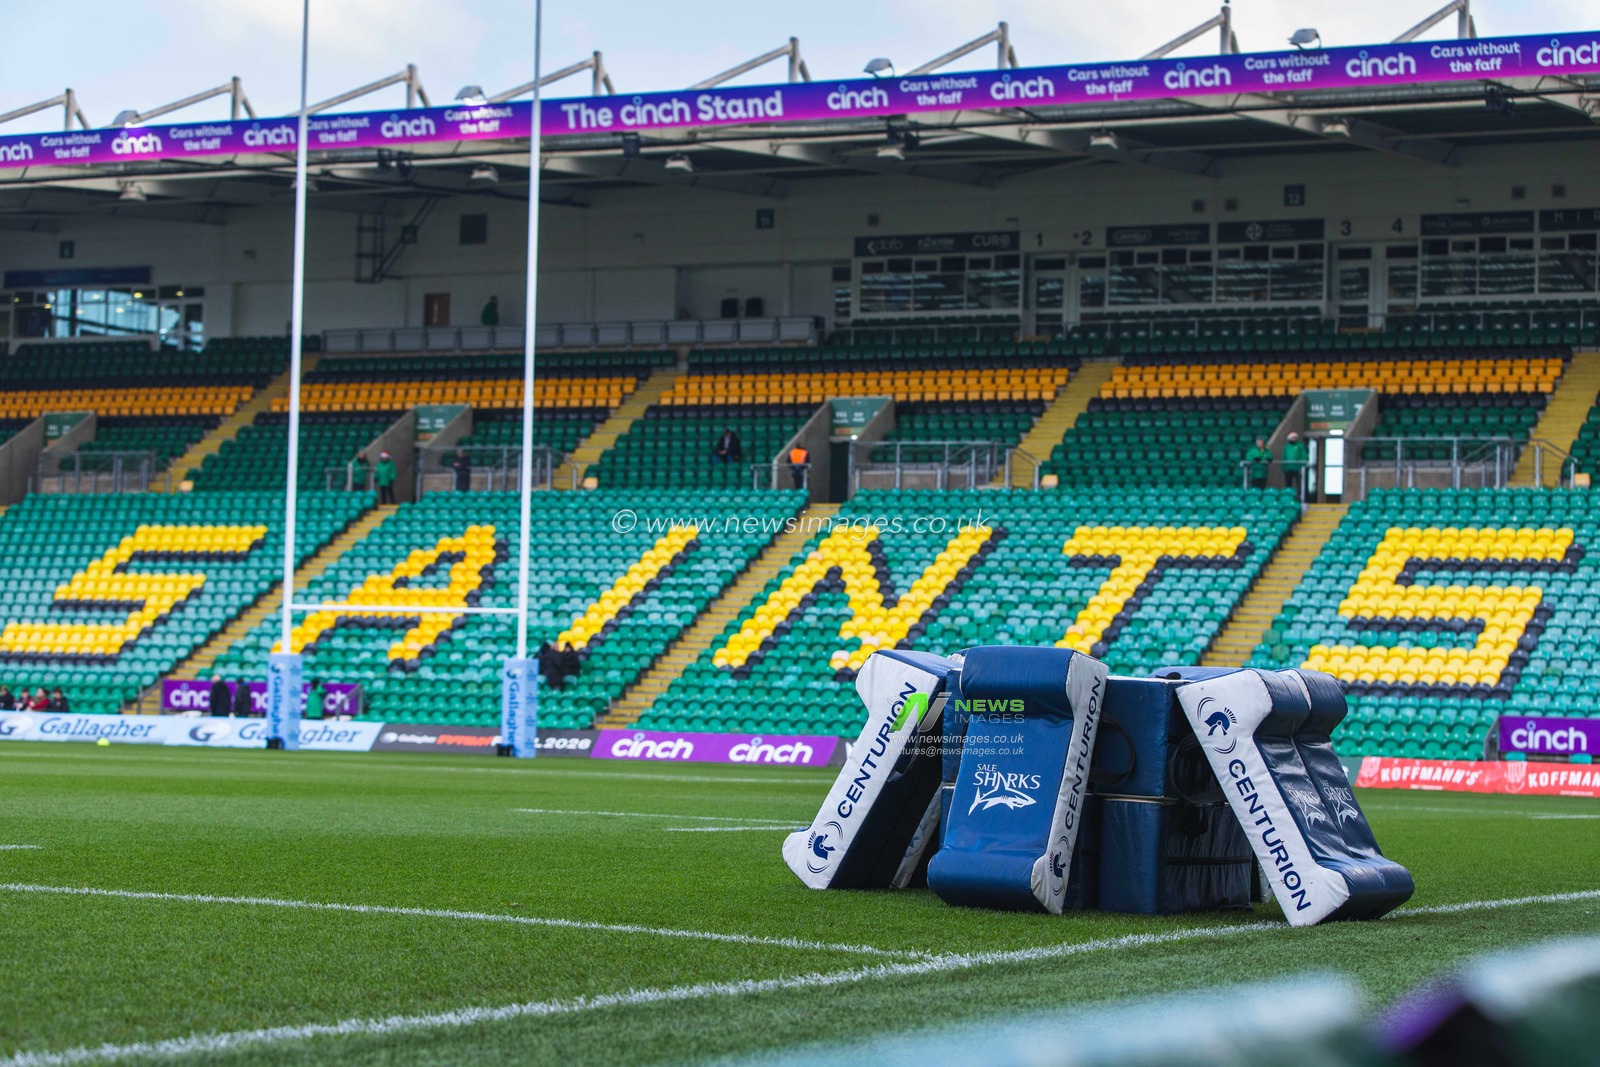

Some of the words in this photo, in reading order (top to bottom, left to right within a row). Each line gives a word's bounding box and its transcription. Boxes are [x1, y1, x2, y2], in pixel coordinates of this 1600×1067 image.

[1244, 57, 1276, 70] Cars
[1277, 54, 1330, 68] without
[1430, 45, 1464, 59] Cars
[1465, 41, 1521, 57] without
[1067, 69, 1098, 81] Cars
[1099, 65, 1149, 79] without
[1163, 62, 1232, 89] cinch
[1345, 50, 1417, 78] cinch
[1449, 60, 1473, 74] the
[1474, 58, 1502, 72] faff
[900, 79, 929, 93] Cars
[931, 77, 978, 91] without
[990, 74, 1054, 100] cinch
[1085, 83, 1107, 95] the
[1108, 80, 1134, 94] faff
[1262, 72, 1285, 85] the
[1286, 69, 1313, 83] faff
[827, 84, 888, 110] cinch
[916, 94, 936, 106] the
[937, 91, 963, 105] faff
[561, 103, 614, 130] The
[620, 95, 692, 126] cinch
[696, 90, 783, 122] Stand
[243, 122, 296, 146] cinch
[381, 112, 436, 139] cinch
[111, 131, 162, 155] cinch
[1340, 220, 1352, 236] 3
[1392, 218, 1404, 233] 4
[1036, 233, 1044, 248] 1
[1081, 231, 1093, 246] 2
[0, 523, 1575, 691] SAINTS
[170, 682, 209, 708] cinc
[40, 716, 158, 742] Gallagher
[1511, 720, 1588, 751] cinch
[543, 736, 592, 750] 2026
[611, 732, 694, 760] cinch
[728, 737, 814, 764] cinch
[837, 681, 918, 819] CENTURION
[1065, 675, 1101, 831] CENTURION
[976, 763, 998, 773] SALE
[1381, 766, 1477, 786] KOFFMANN'S
[973, 771, 1042, 790] SHARKS
[1228, 758, 1312, 911] CENTURION
